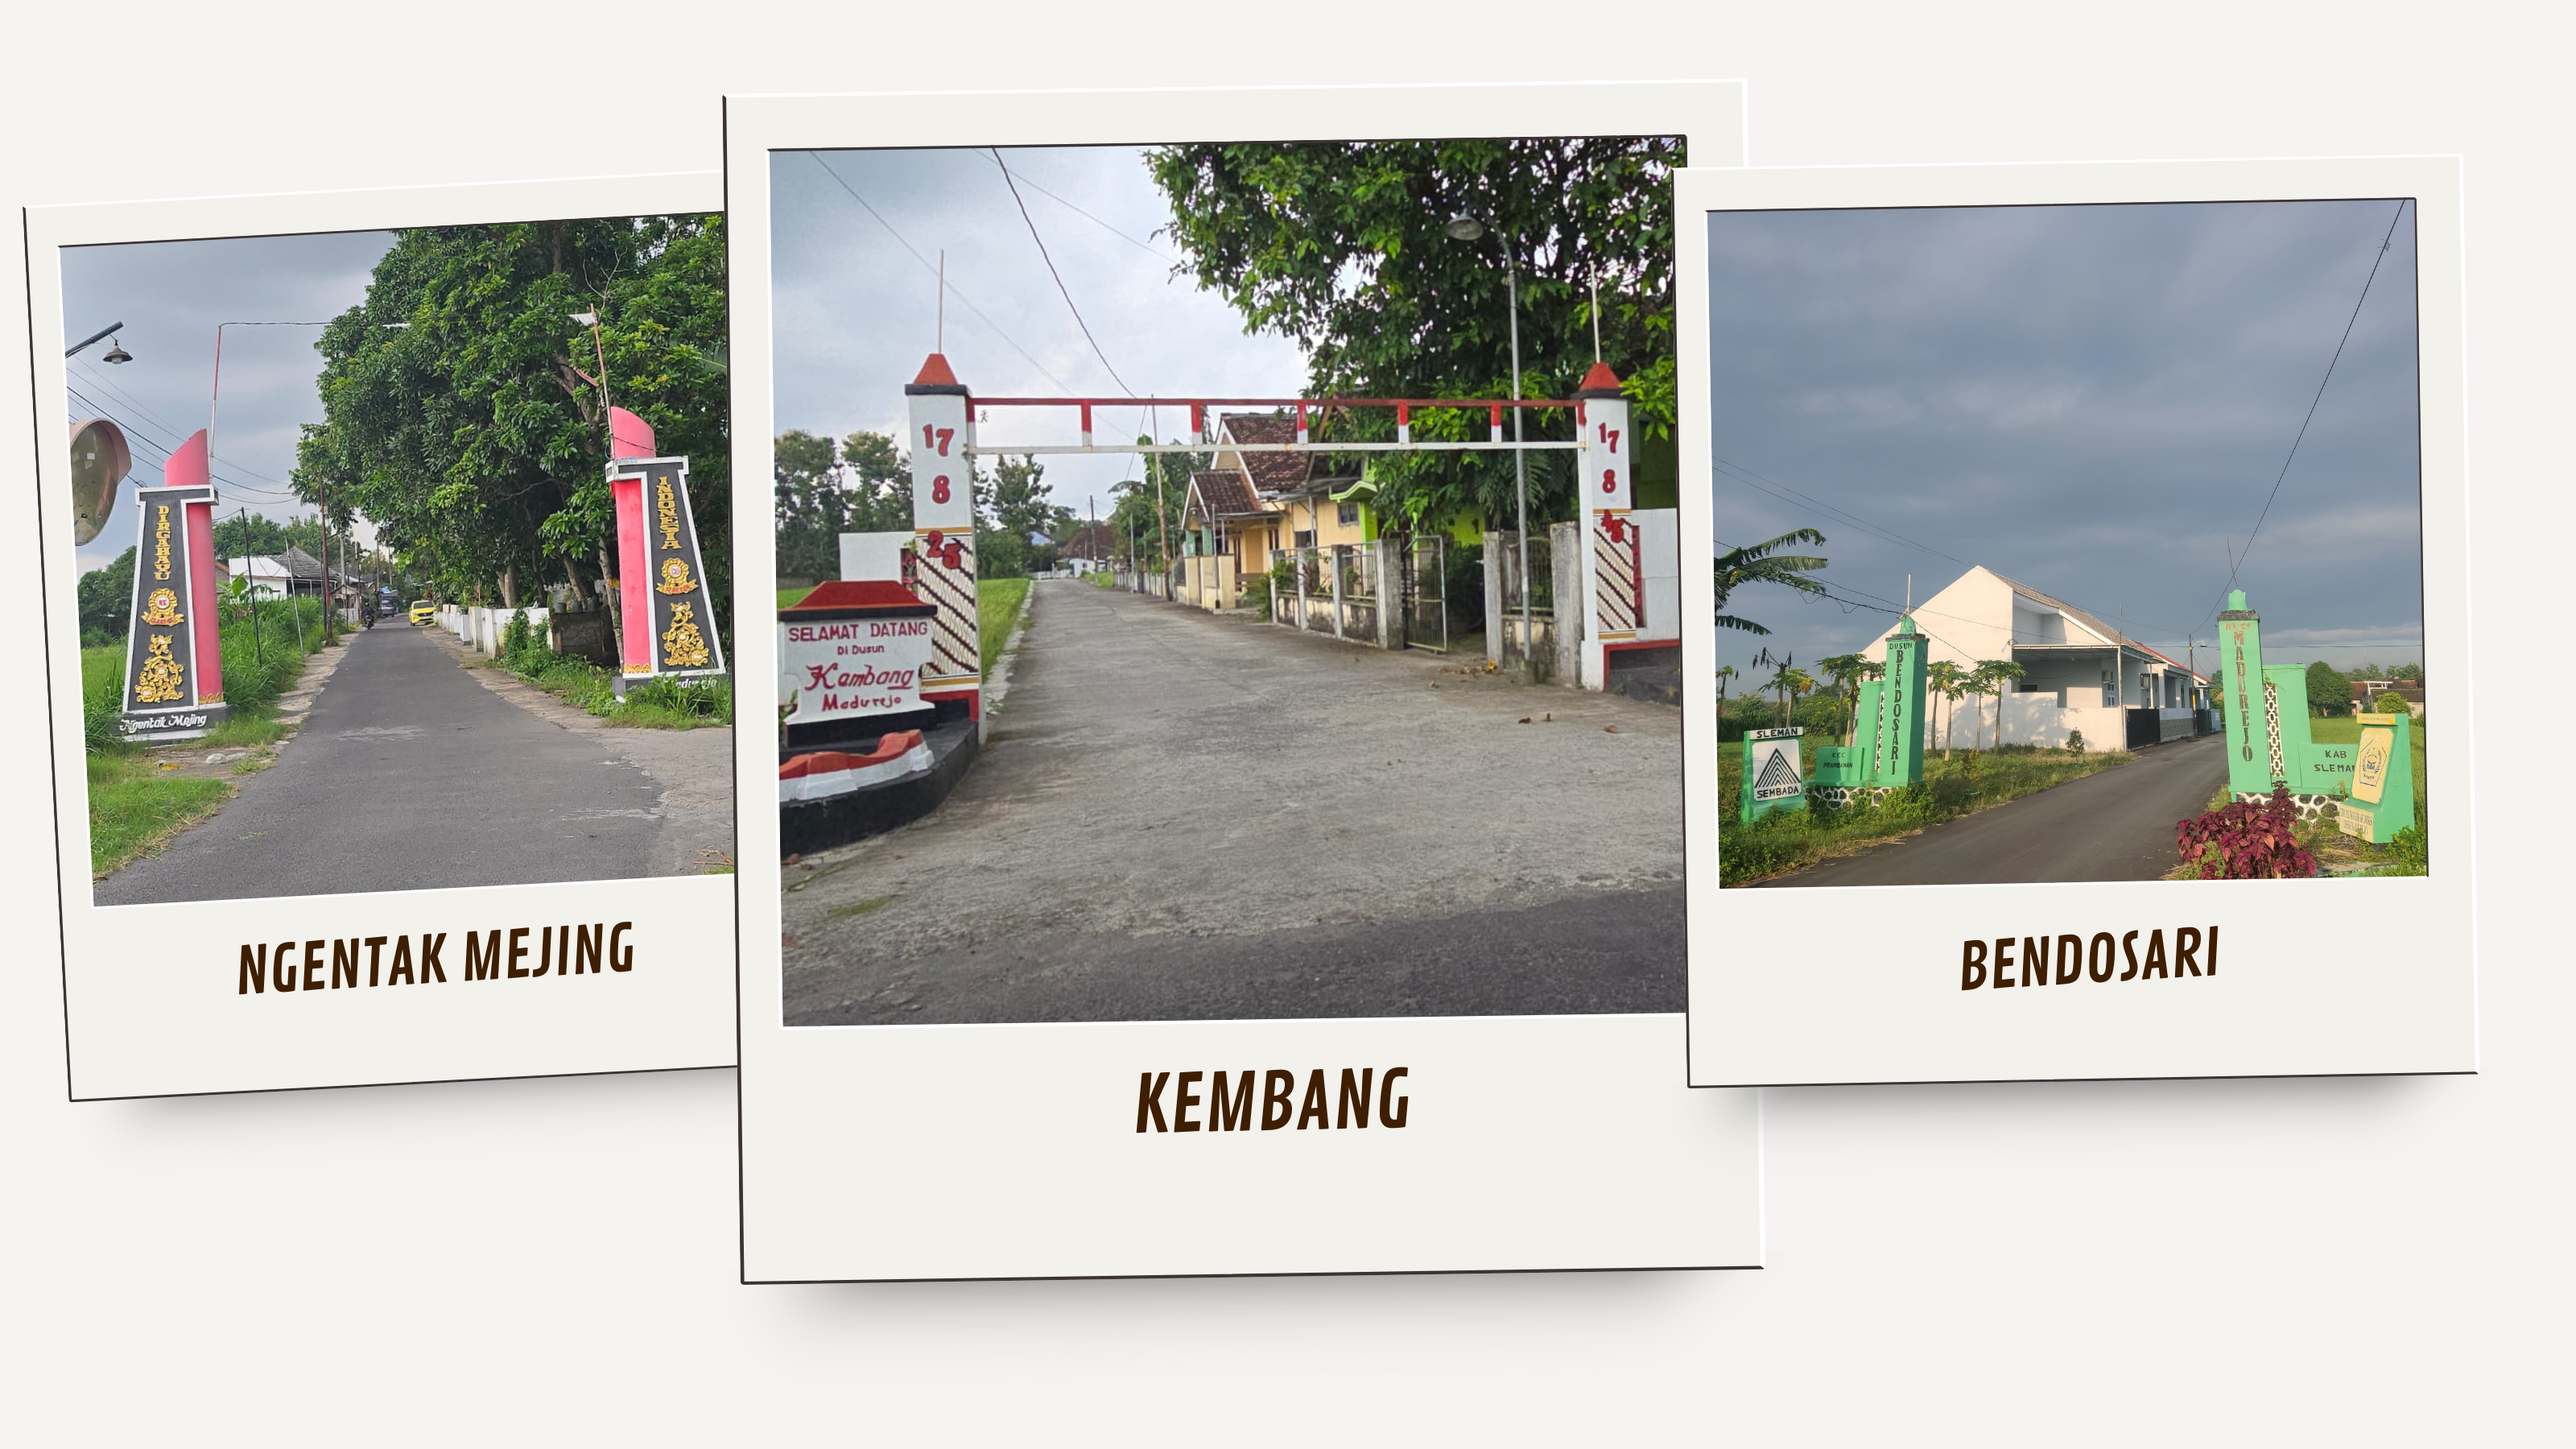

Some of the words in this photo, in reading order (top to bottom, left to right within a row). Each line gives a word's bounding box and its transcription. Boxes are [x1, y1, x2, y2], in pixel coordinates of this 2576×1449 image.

[923, 423, 955, 457] 17
[1599, 422, 1620, 453] 17
[932, 475, 950, 504] 8
[1602, 469, 1616, 493] 8
[656, 476, 683, 550] INDONESIA
[154, 506, 171, 580] DIRGAHAYU
[927, 530, 962, 569] 25
[788, 624, 859, 642] SELAMAT
[870, 621, 927, 638] DATANG
[2225, 621, 2252, 631] DESA
[852, 644, 885, 654] Dusun
[1889, 642, 1913, 650] DUSUN
[822, 693, 902, 712] Madurejo
[2233, 630, 2253, 762] MADUREJO
[168, 714, 208, 728] Mejing
[1891, 650, 1904, 775] BENDOSARI
[1757, 727, 1798, 739] SLEMAN
[2325, 749, 2347, 759] KAB
[1757, 786, 1799, 799] SEMBADA
